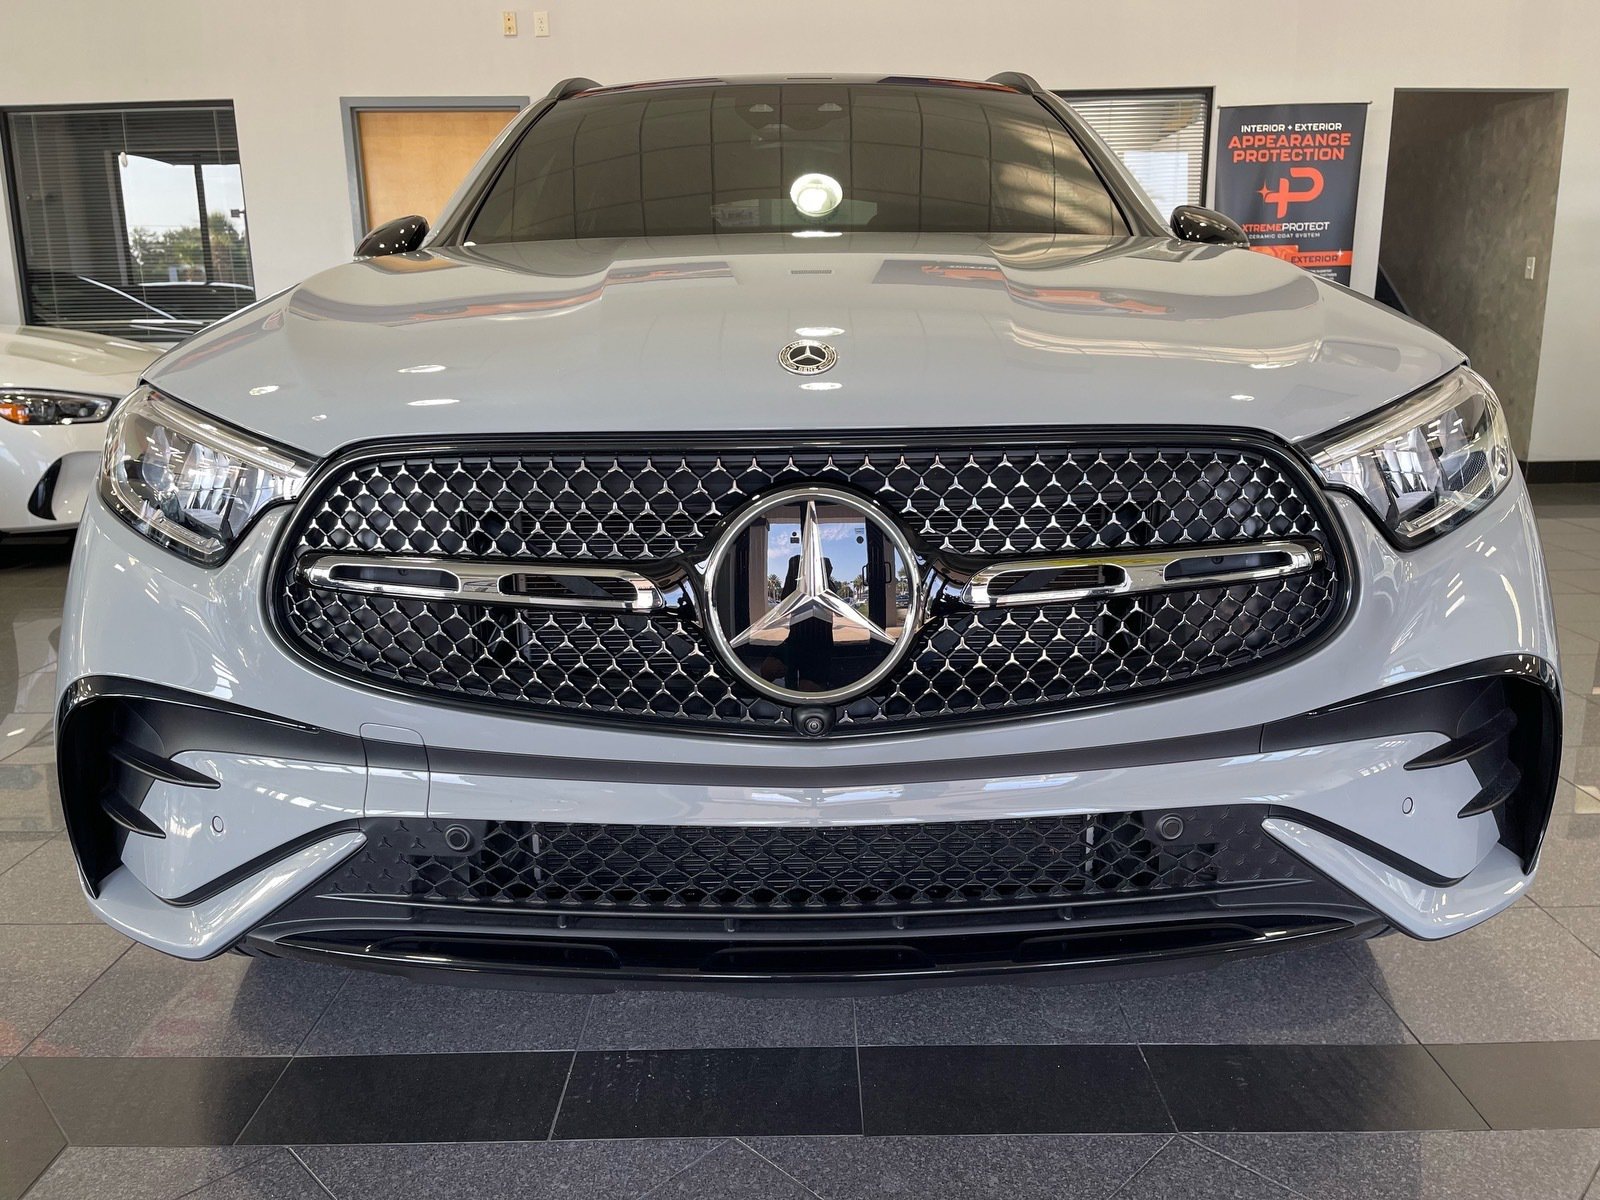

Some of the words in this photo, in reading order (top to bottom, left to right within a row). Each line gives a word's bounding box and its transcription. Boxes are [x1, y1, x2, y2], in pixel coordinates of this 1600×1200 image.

[1241, 124, 1286, 133] INTERIOR
[1294, 122, 1343, 132] EXTERIOR
[1228, 133, 1352, 149] APPEARANCE
[1233, 148, 1345, 163] PROTECTION
[1290, 255, 1339, 264] EXTERIOR
